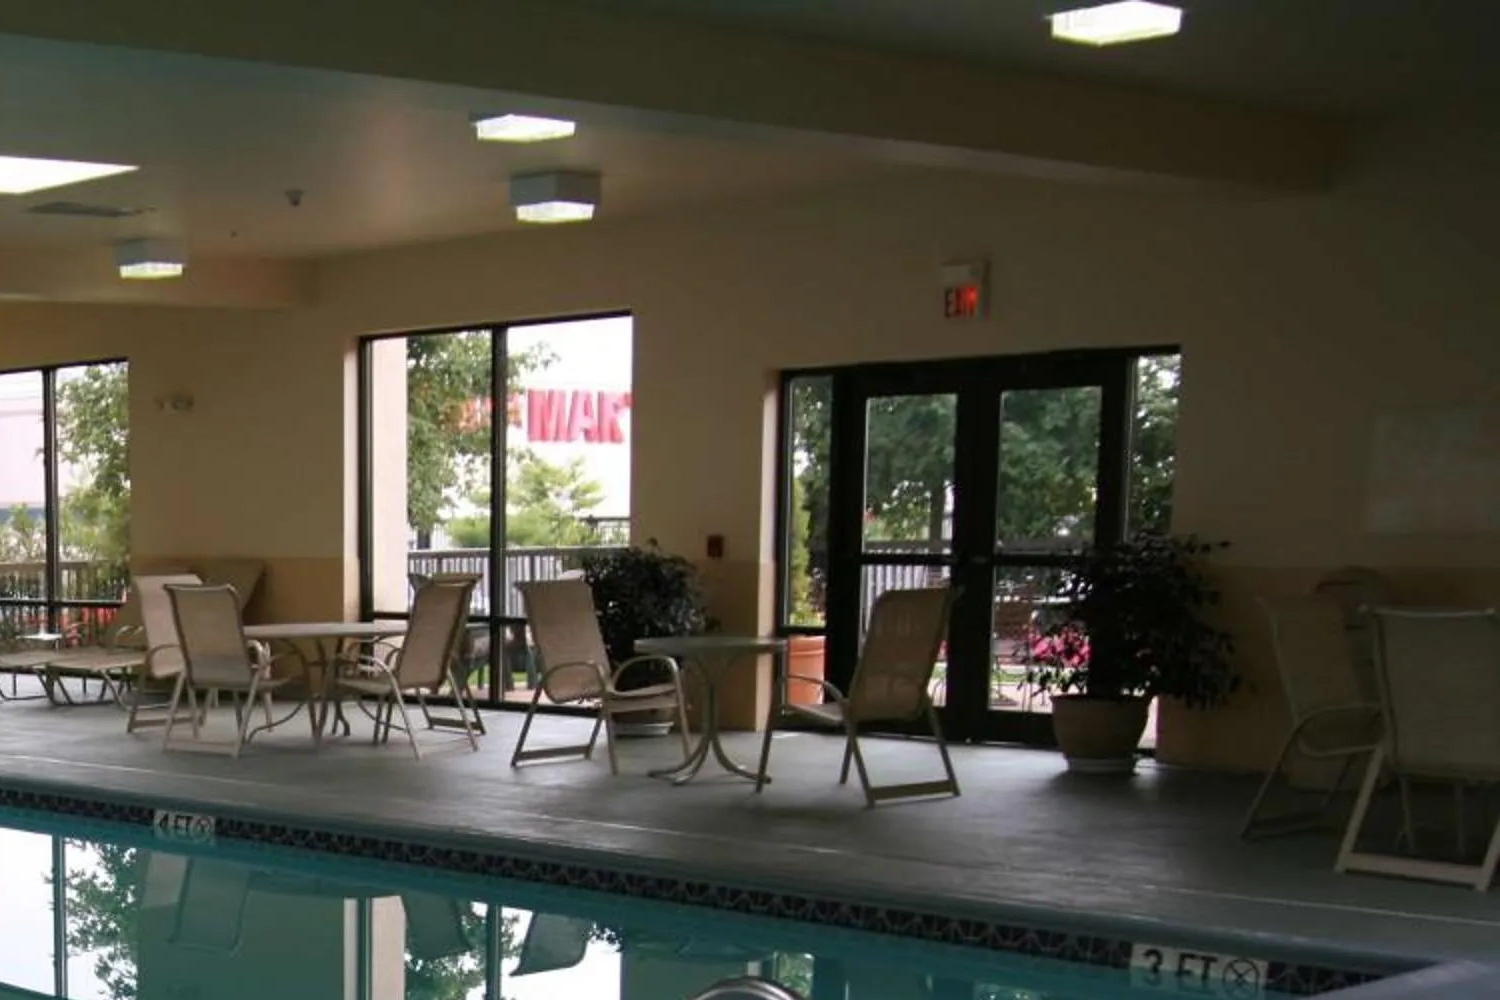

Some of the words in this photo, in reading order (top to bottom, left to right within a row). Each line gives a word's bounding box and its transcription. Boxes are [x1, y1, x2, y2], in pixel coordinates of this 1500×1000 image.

[944, 286, 977, 319] EXIT
[527, 389, 634, 443] MAR
[1176, 952, 1218, 980] FT
